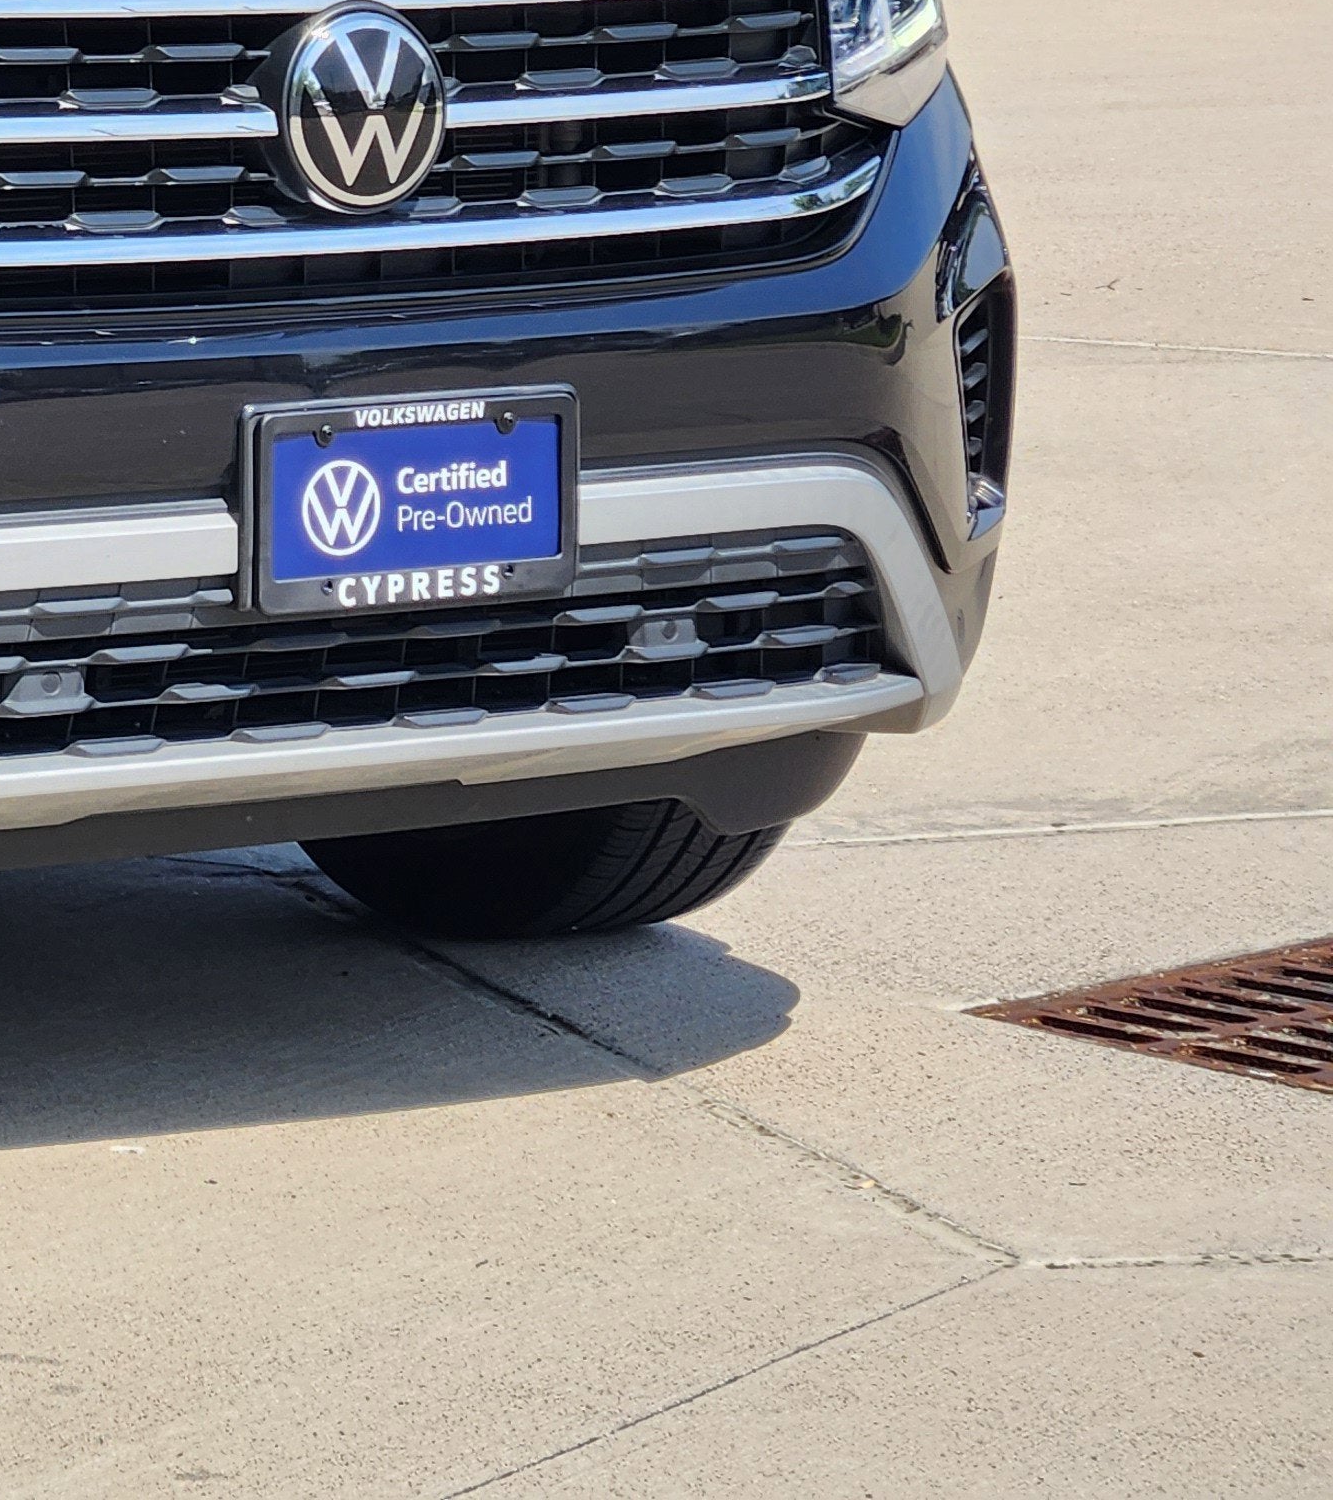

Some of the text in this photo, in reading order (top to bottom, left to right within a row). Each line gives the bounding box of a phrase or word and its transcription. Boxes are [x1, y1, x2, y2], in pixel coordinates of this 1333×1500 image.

[355, 401, 485, 428] VOLKSWAGEN
[397, 460, 507, 494] Certified
[303, 460, 379, 554] VW
[397, 495, 533, 532] Pre-Owned
[339, 565, 501, 607] CYPRESS
